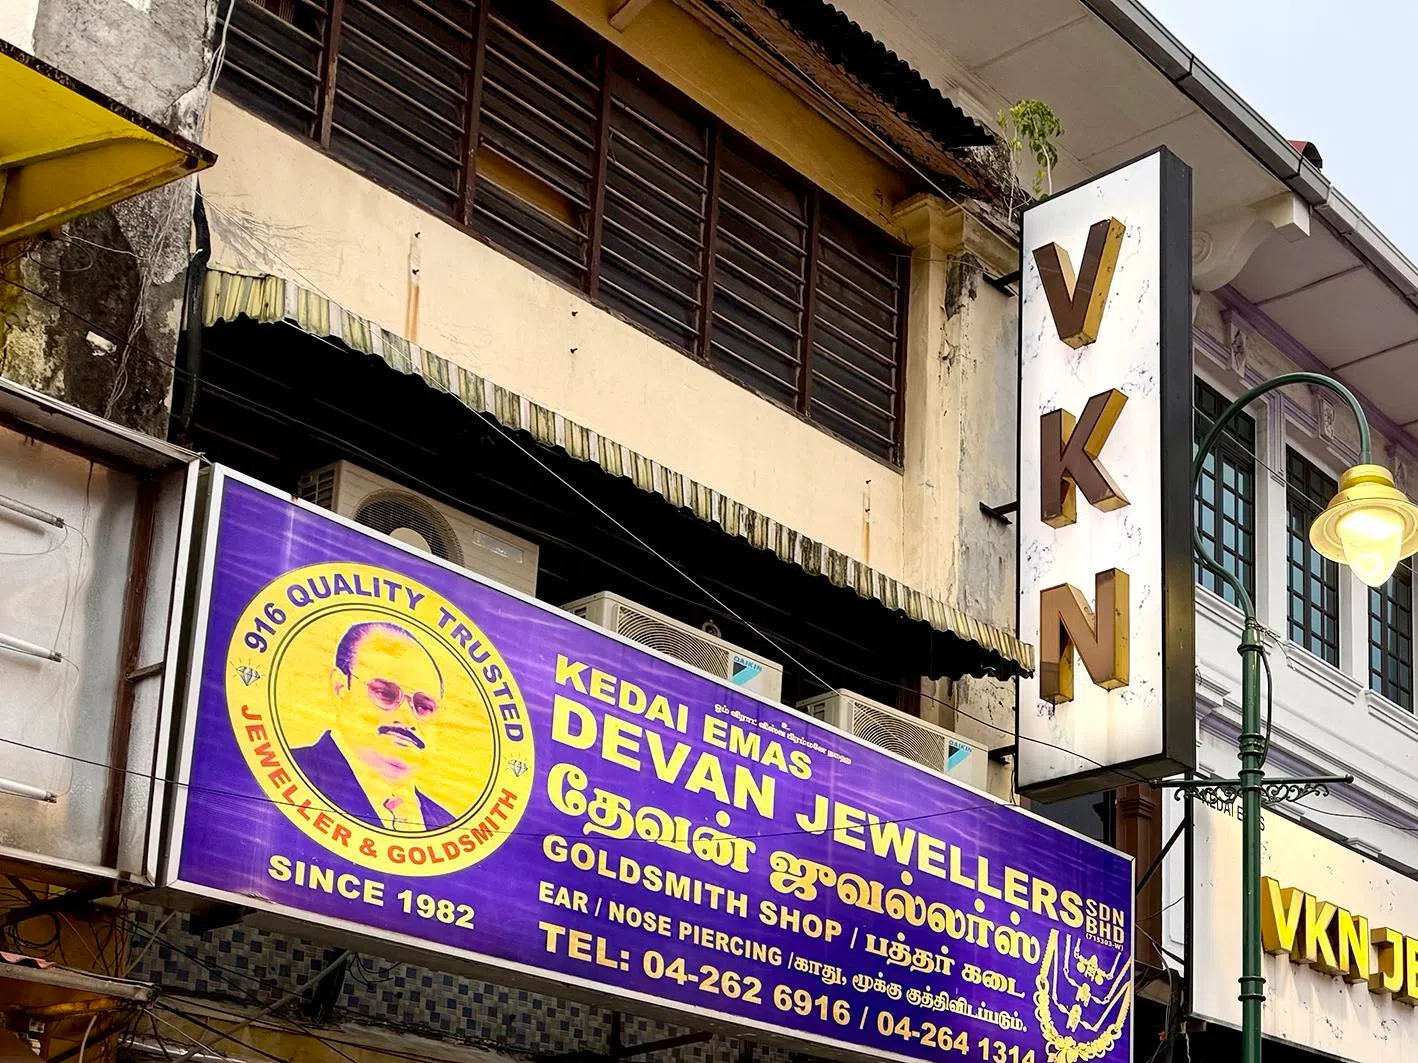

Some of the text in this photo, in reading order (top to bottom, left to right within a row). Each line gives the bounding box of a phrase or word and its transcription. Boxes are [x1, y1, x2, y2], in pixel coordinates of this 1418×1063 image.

[1031, 216, 1131, 704] VKN
[243, 572, 525, 743] 916 QUALITY TRUSTED
[554, 654, 814, 782] KEDAI EMAS
[733, 655, 763, 672] DAIKIN
[241, 704, 519, 866] JEWELLER & GOLDSMITH
[551, 693, 1084, 929] DEVAN JEWELLERS
[267, 853, 476, 929] SINCE 1982
[538, 880, 589, 917] EAR
[608, 901, 673, 941] NOSE
[677, 921, 783, 969] PIERCING
[541, 834, 749, 920] GOLDSMITH
[758, 897, 843, 943] SHOP
[865, 932, 955, 976] பத்தர்
[961, 960, 1026, 999] கடை
[546, 761, 1042, 965] தேவன் ஜுவல்லர்ஸ்
[1085, 897, 1125, 928] SDN
[537, 921, 632, 975] TEL:
[642, 950, 763, 1009] 04-262
[772, 983, 852, 1029] 6916
[877, 1011, 970, 1057] 04-264
[1085, 919, 1126, 943] BHD
[1261, 875, 1371, 984] VKN
